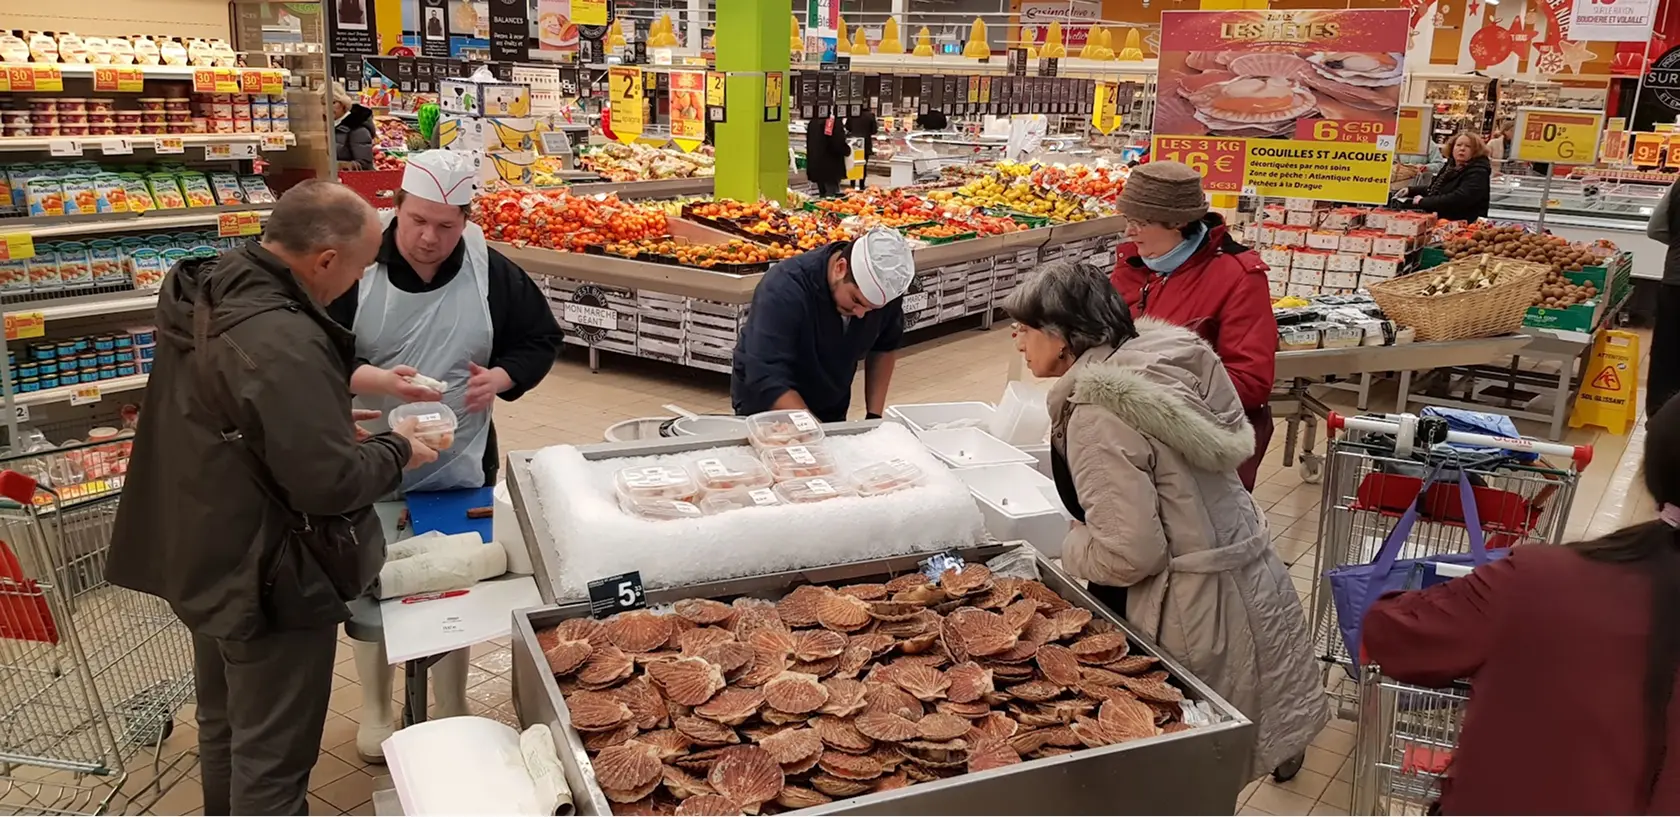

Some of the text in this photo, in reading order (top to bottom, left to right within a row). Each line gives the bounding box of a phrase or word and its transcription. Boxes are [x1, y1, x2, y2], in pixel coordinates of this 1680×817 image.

[493, 16, 524, 25] BALANCES
[1576, 15, 1608, 23] BOUCHERIE
[1220, 21, 1265, 40] LES
[623, 75, 634, 99] 2
[715, 76, 721, 90] 2
[773, 77, 778, 90] 1
[1313, 120, 1384, 141] 6 €50
[1542, 123, 1557, 143] 0
[1342, 133, 1369, 143] le kg
[247, 145, 253, 155] 2
[1161, 139, 1241, 152] LES 3 KG
[1557, 140, 1575, 159] G
[1251, 147, 1388, 163] COQUILLES ST JACQUES
[1638, 146, 1650, 160] 9
[1250, 160, 1298, 170] décortiquées
[1299, 163, 1313, 171] par
[1308, 173, 1352, 182] Atlantique
[1352, 175, 1388, 184] Nord-est
[1294, 182, 1323, 191] Drague
[565, 304, 583, 314] MON
[574, 325, 608, 343] MEILLEUR
[1597, 352, 1630, 362] ATTENTION
[1581, 393, 1627, 406] SOL GLISSANT
[16, 407, 24, 417] 2
[618, 580, 636, 607] 5
